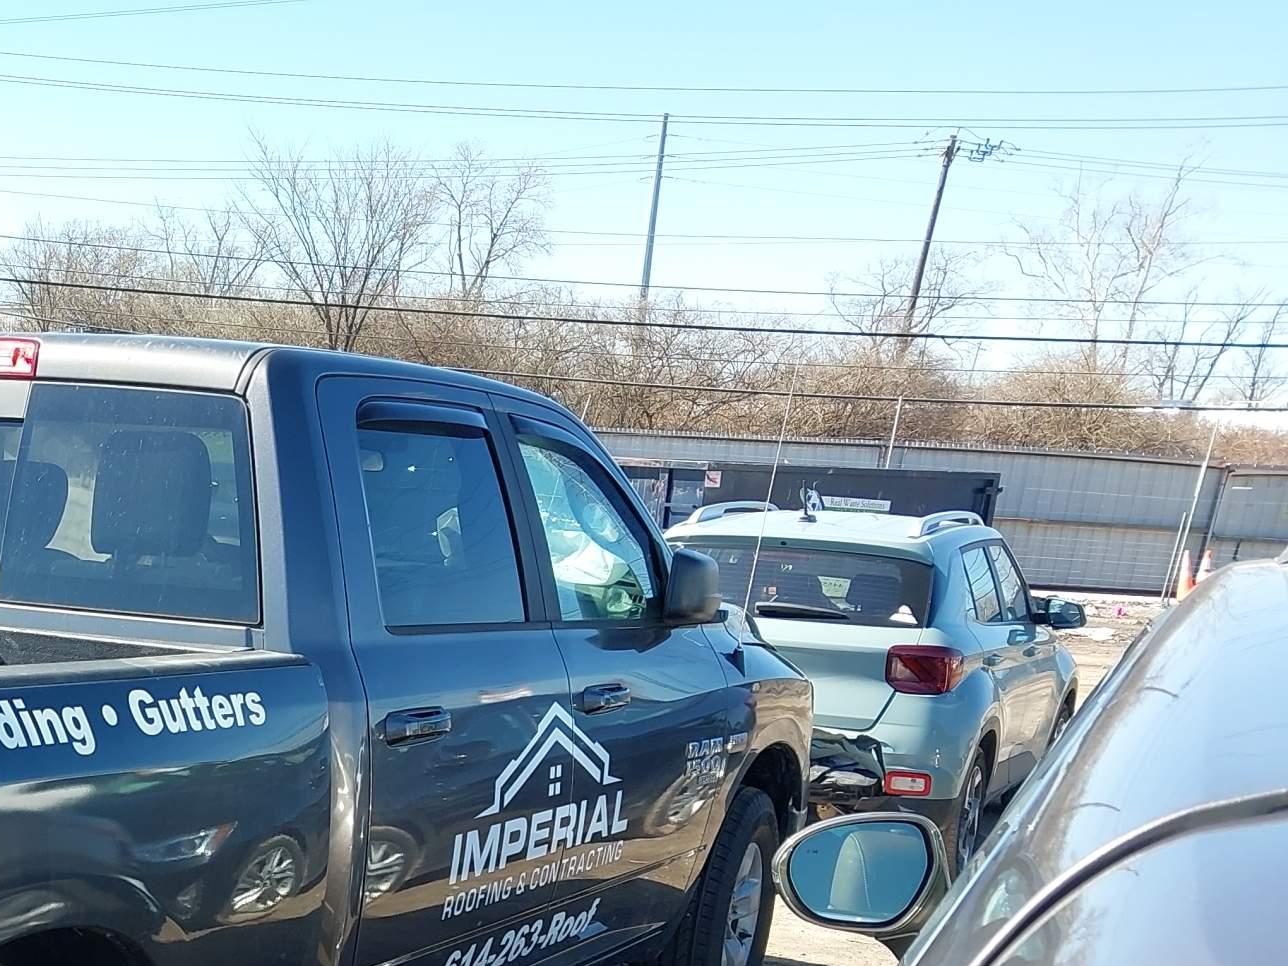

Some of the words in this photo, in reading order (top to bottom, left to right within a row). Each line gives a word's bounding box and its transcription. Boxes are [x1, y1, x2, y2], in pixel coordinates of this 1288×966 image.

[127, 688, 266, 736] Gutters
[448, 789, 629, 886] IMPERIAL
[441, 884, 513, 921] ROOFING
[516, 873, 526, 894] &
[529, 840, 624, 891] CONTRACTING
